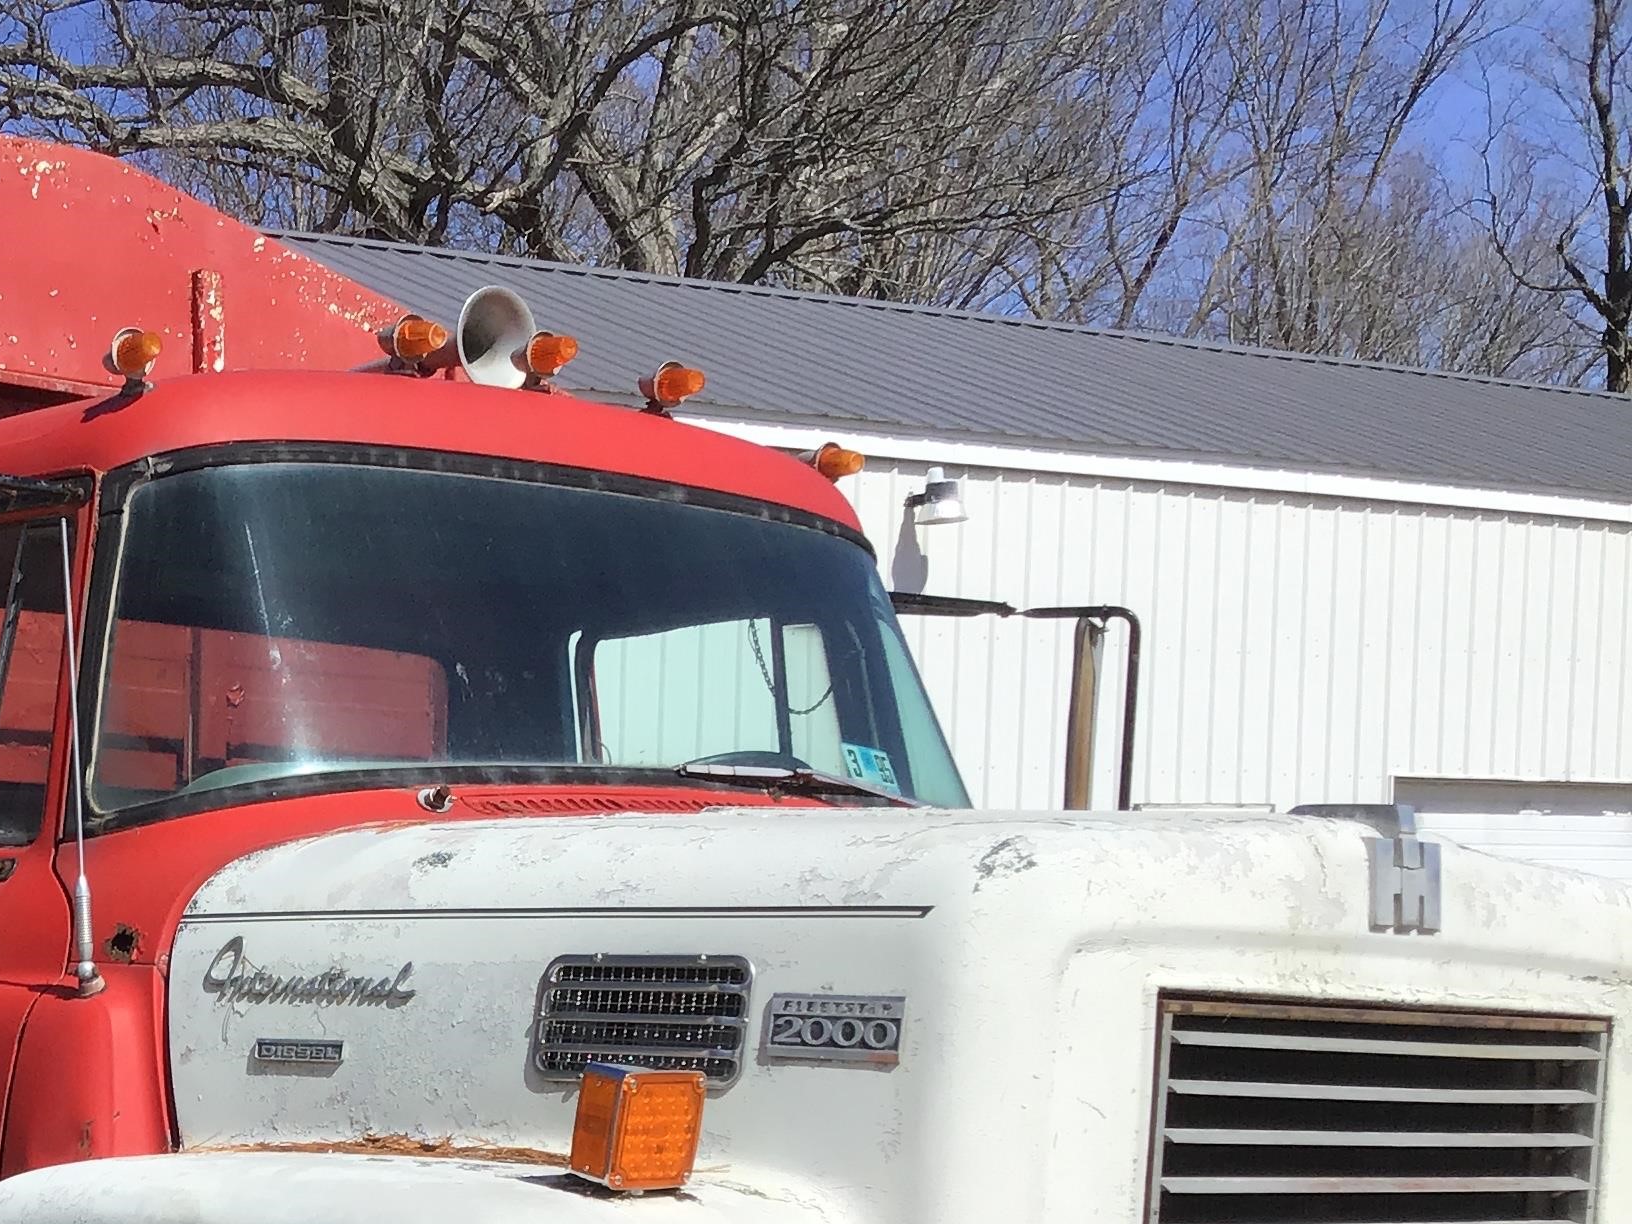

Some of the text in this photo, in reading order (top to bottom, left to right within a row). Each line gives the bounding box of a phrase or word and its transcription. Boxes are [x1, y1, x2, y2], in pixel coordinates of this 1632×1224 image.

[847, 749, 863, 778] 3
[203, 935, 417, 1009] International
[772, 1015, 898, 1048] 2000
[259, 1043, 341, 1060] DIESEL
